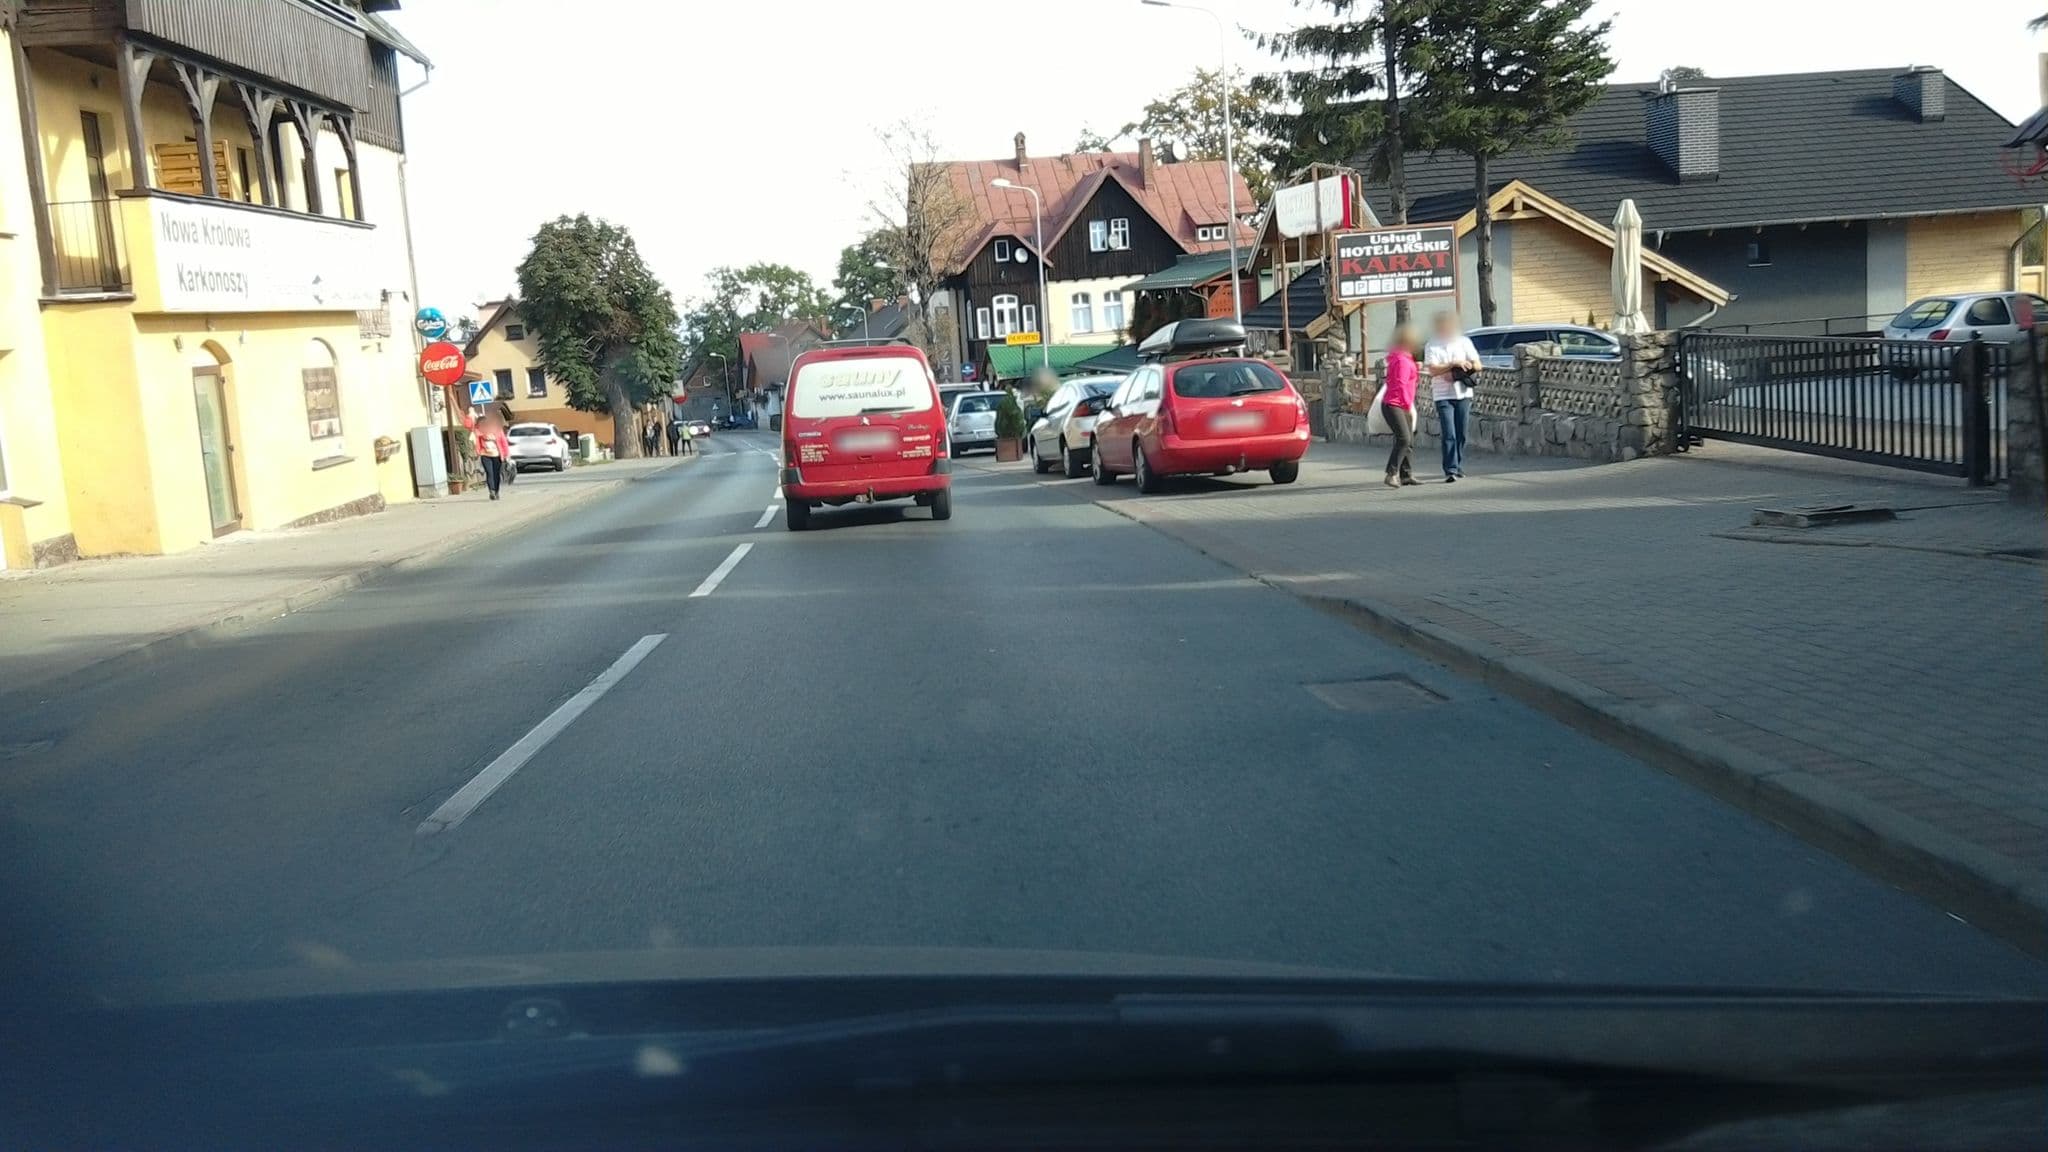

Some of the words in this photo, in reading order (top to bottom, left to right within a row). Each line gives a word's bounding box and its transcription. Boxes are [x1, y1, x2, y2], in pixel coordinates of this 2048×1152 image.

[160, 211, 199, 243] Nowa
[1340, 240, 1450, 258] HOTELARSKIE
[1341, 251, 1451, 276] KARAT
[176, 262, 249, 299] Karkonoszy
[818, 387, 906, 401] www.saunalux.pl
